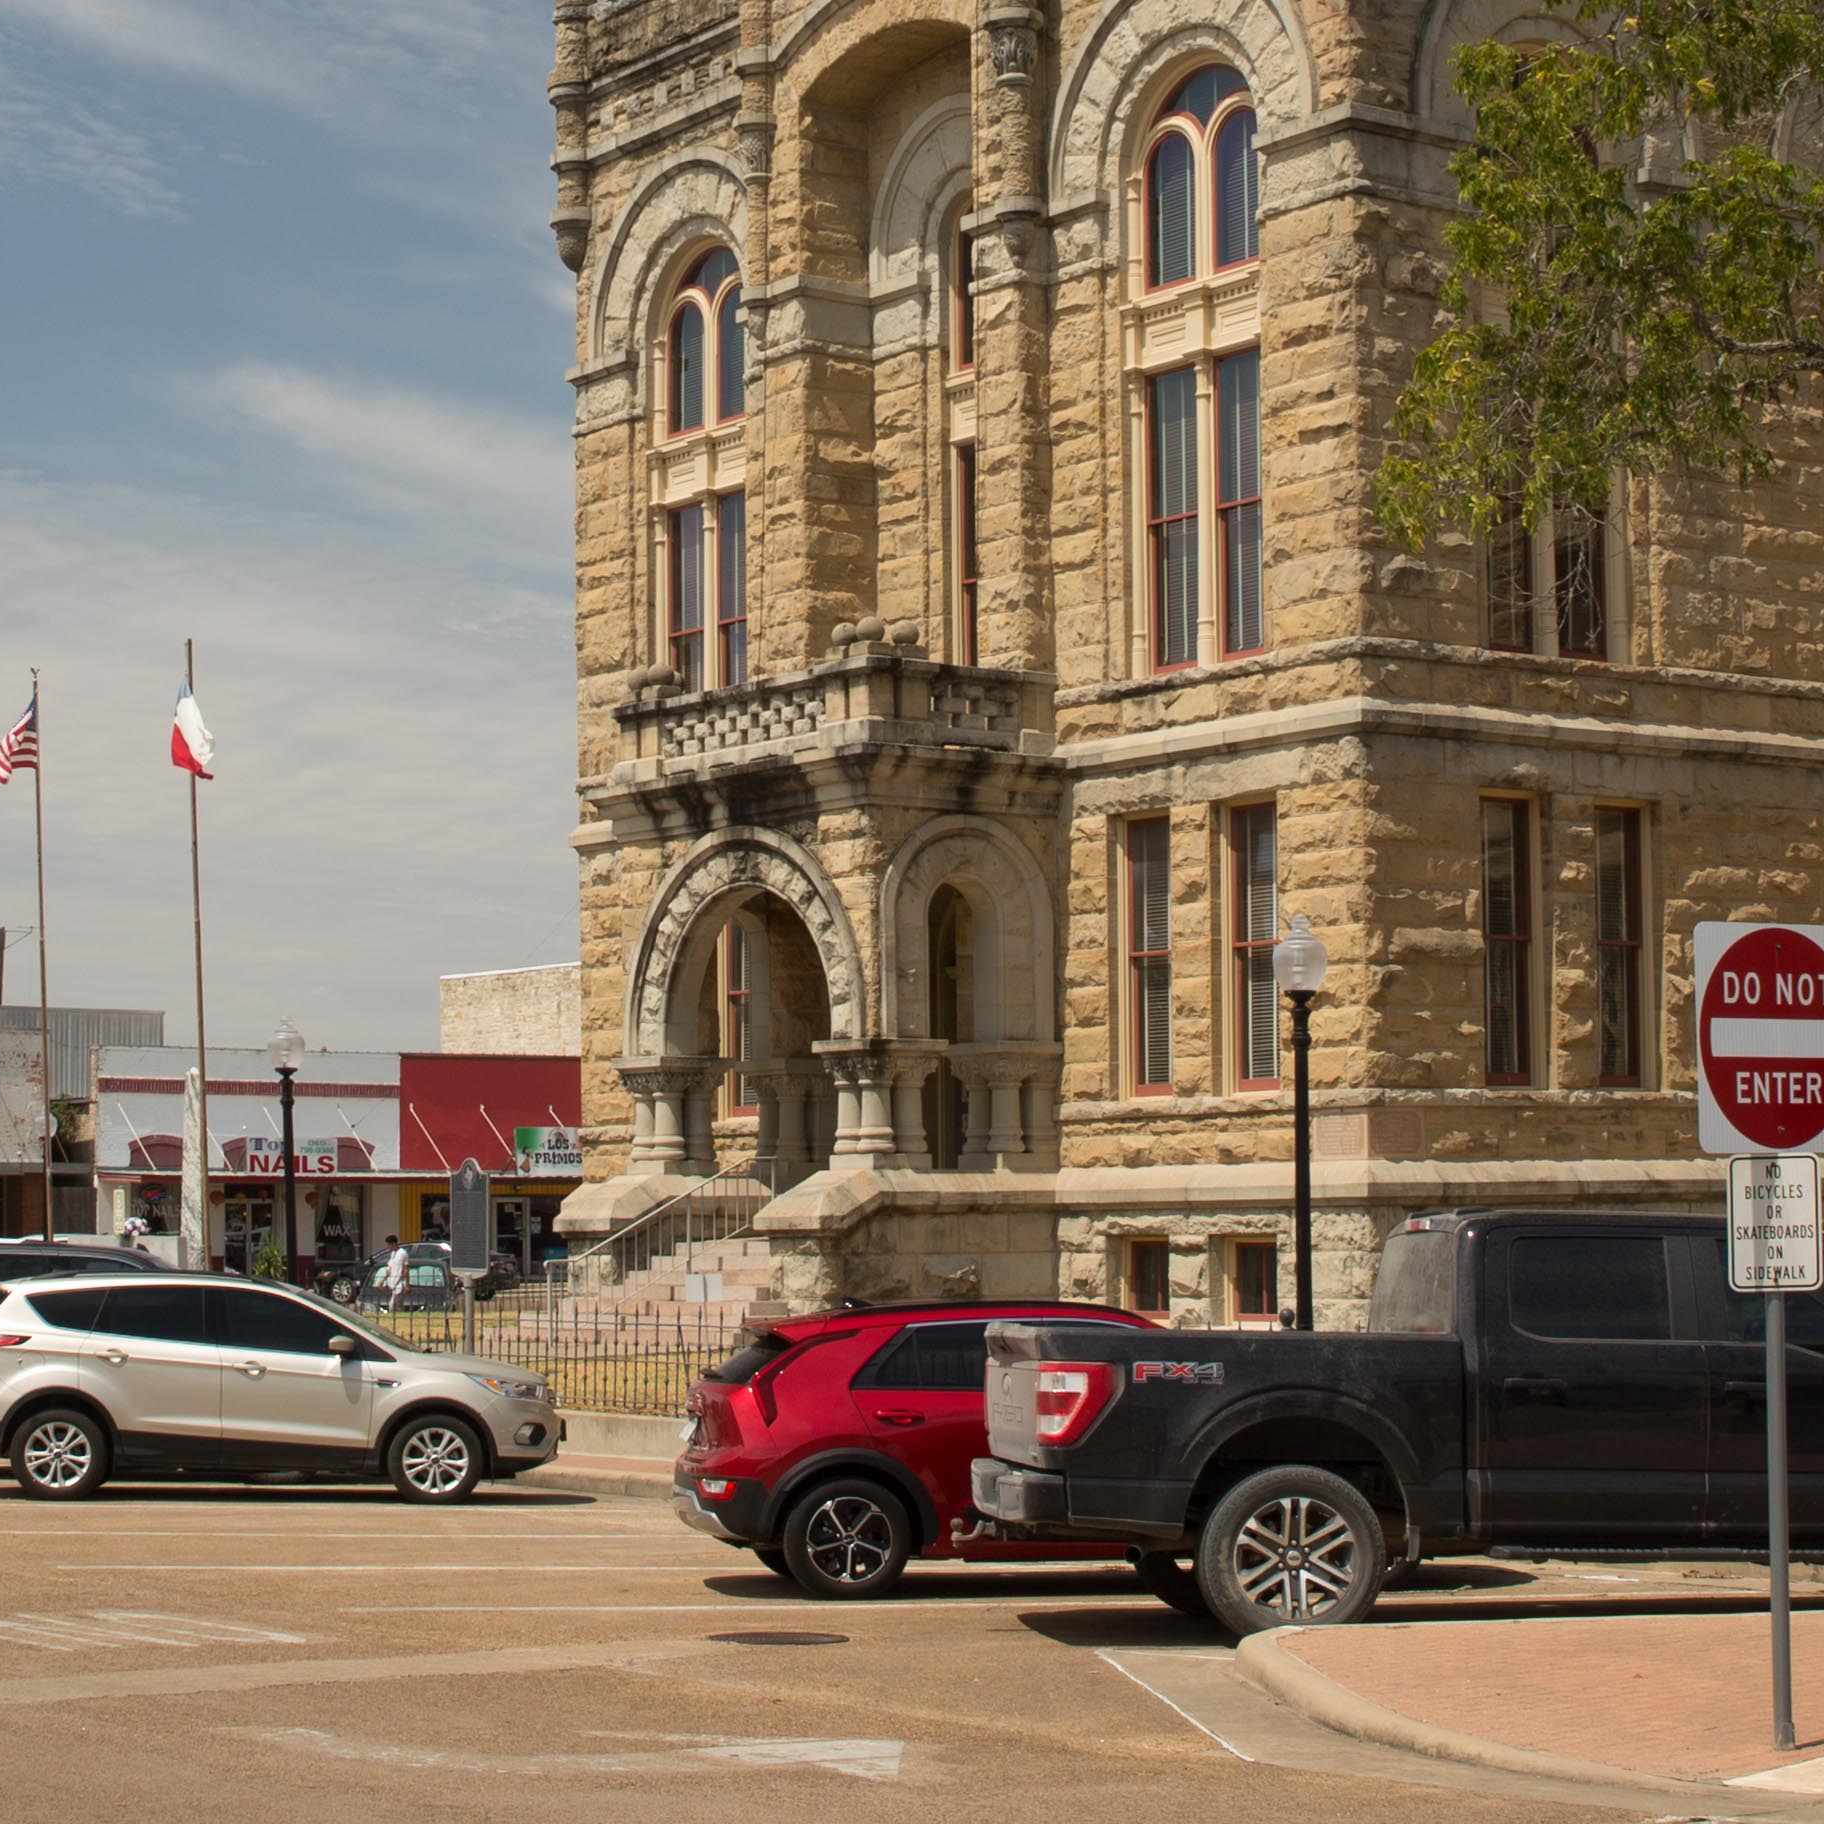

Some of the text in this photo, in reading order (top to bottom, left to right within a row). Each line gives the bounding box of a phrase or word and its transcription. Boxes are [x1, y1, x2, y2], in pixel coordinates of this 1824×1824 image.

[1723, 971, 1761, 1005] DO
[1736, 1071, 1823, 1105] ENTER
[547, 1138, 569, 1150] LOS
[249, 1154, 335, 1173] NAILS
[534, 1152, 583, 1164] PRIMOS
[1765, 1164, 1781, 1179] NO
[1744, 1184, 1804, 1200] BICYCLES
[1766, 1204, 1782, 1219] OR
[323, 1223, 351, 1236] WAX
[1736, 1224, 1814, 1240] SKATEBOARDS
[1767, 1245, 1783, 1260] ON
[1745, 1265, 1806, 1280] SIDEWALK
[1133, 1361, 1224, 1384] FX4
